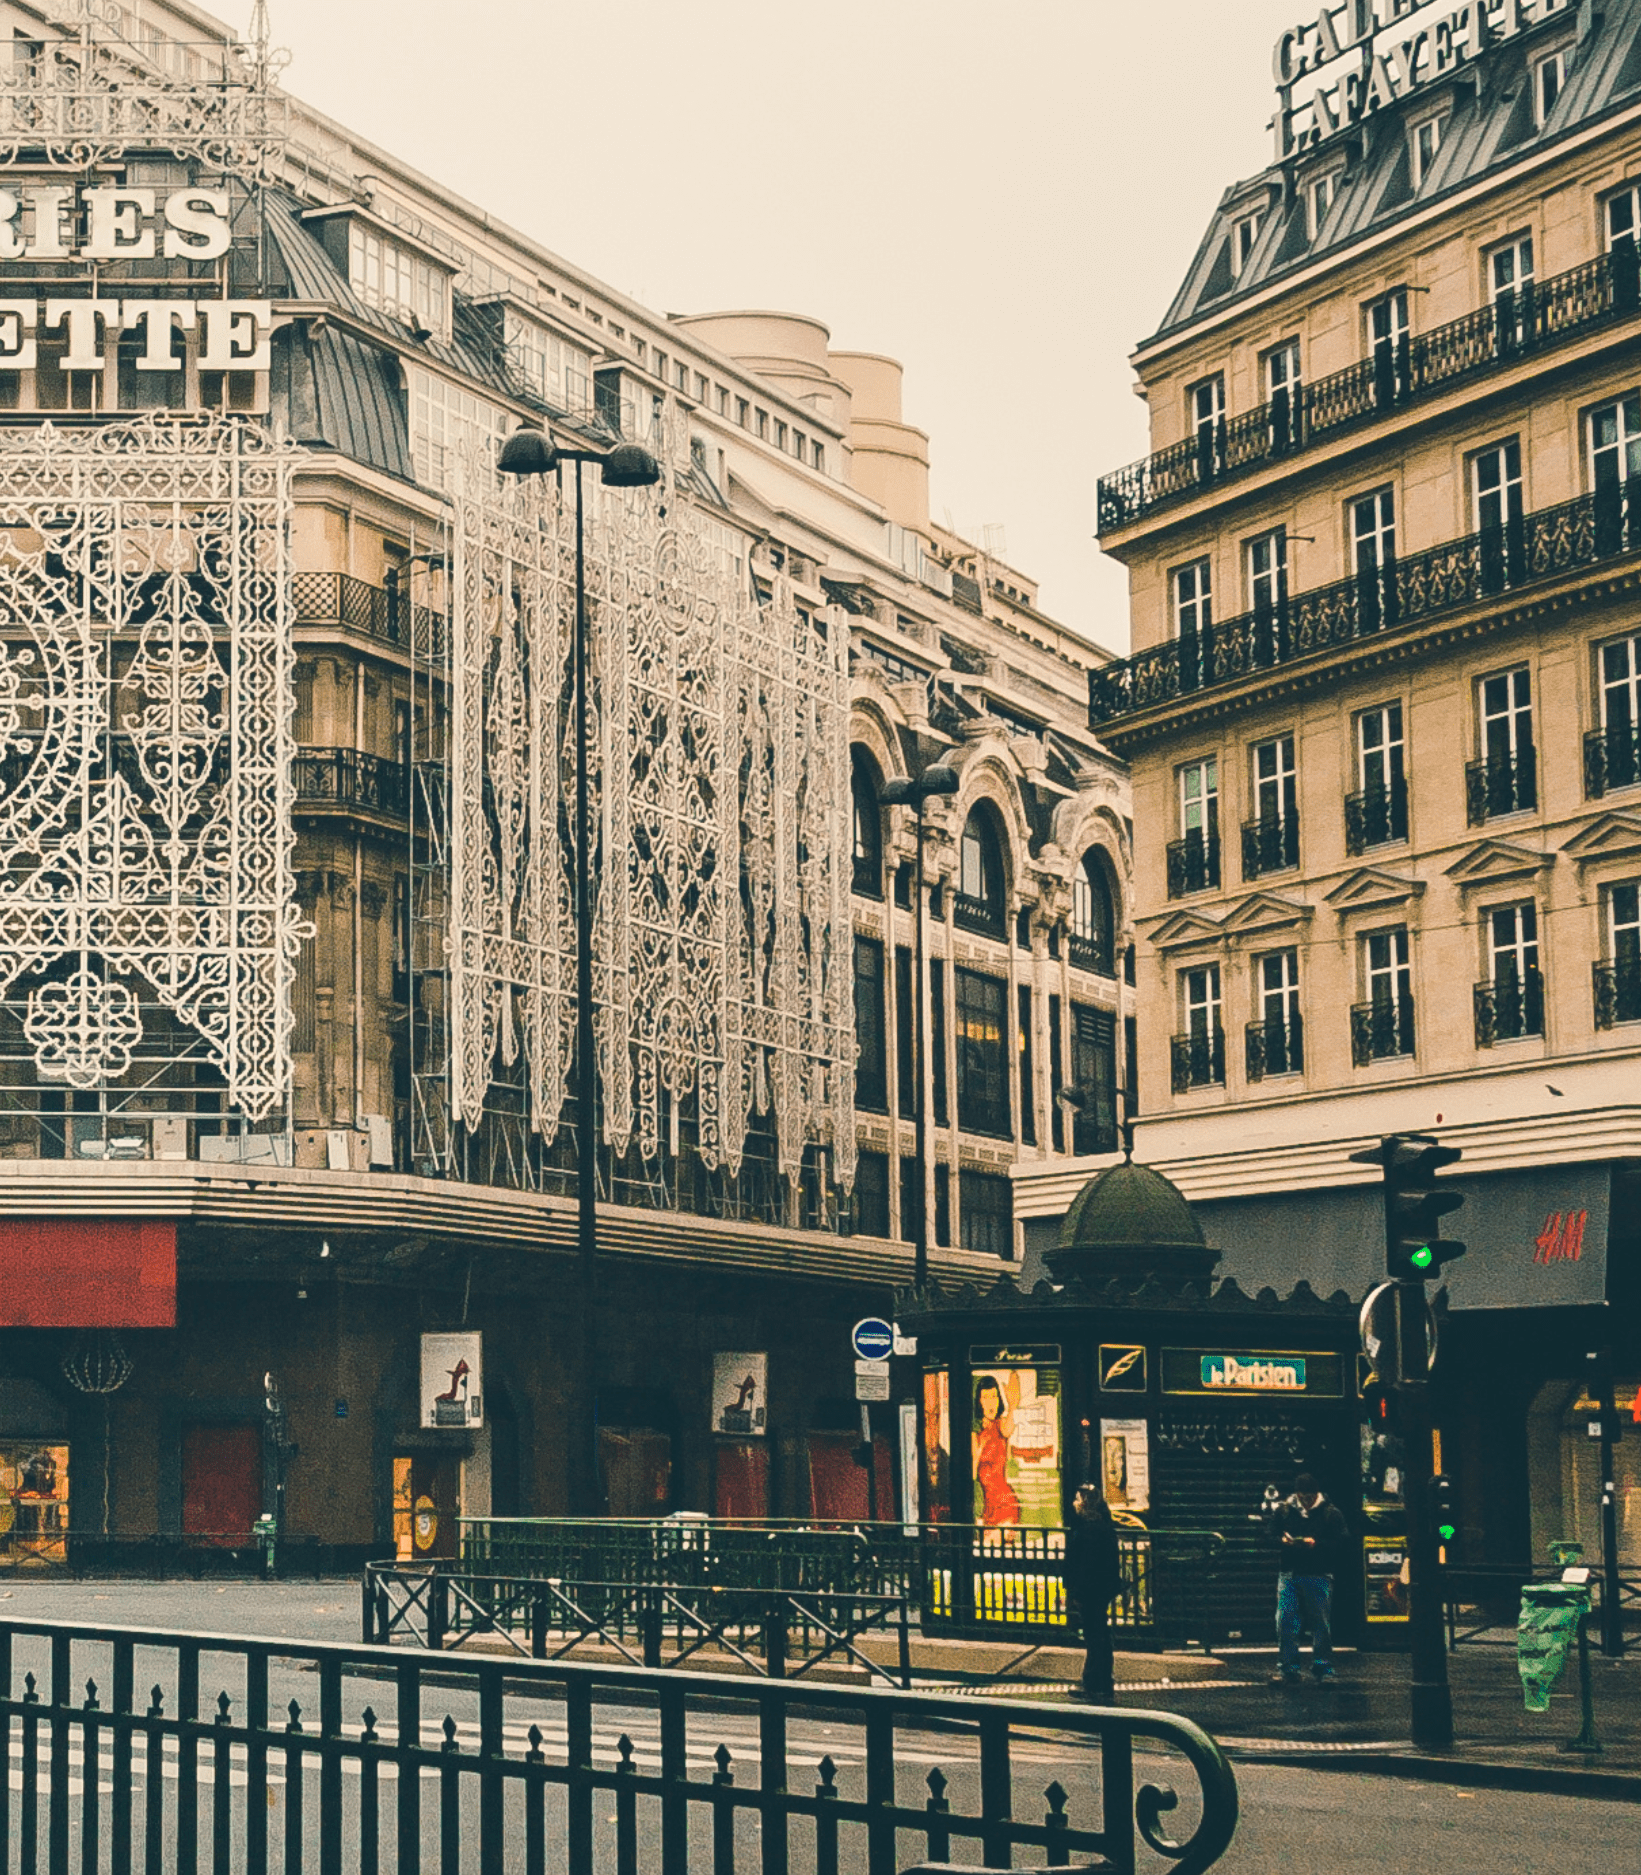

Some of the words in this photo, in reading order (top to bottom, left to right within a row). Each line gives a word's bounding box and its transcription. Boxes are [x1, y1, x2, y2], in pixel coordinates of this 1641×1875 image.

[1270, 0, 1569, 162] LAFAYETT
[1211, 1364, 1224, 1385] le
[1224, 1357, 1297, 1387] Parisien
